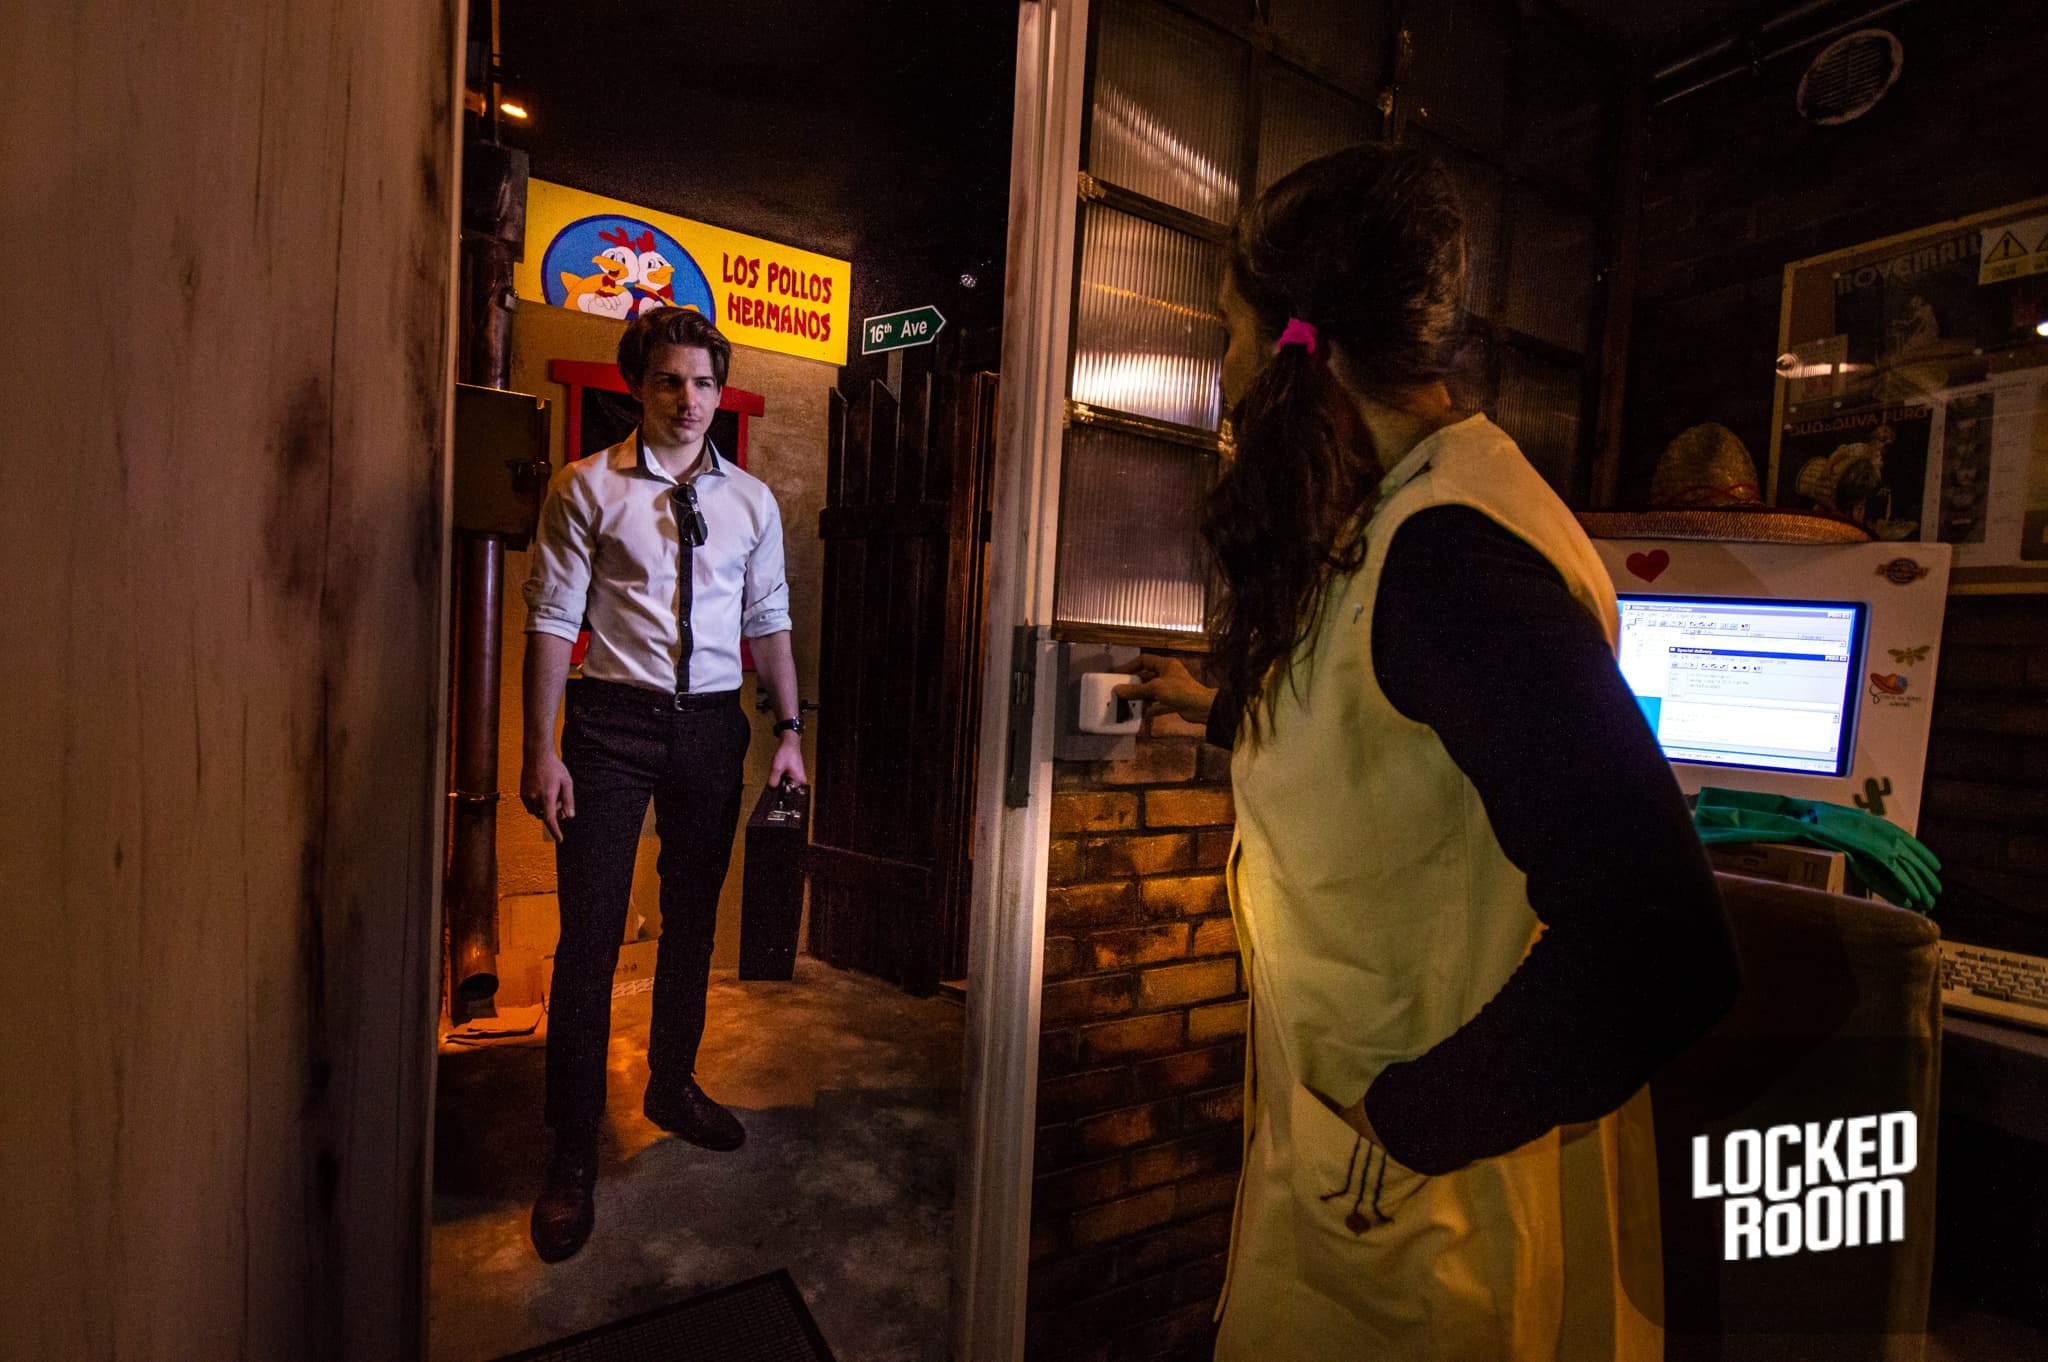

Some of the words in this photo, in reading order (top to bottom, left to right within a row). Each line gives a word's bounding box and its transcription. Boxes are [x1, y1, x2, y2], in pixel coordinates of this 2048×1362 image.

[722, 252, 760, 289] LOS
[768, 262, 832, 304] POLLOS
[728, 293, 831, 342] HERMANOS
[870, 322, 892, 344] 16th
[901, 319, 928, 339] Ave
